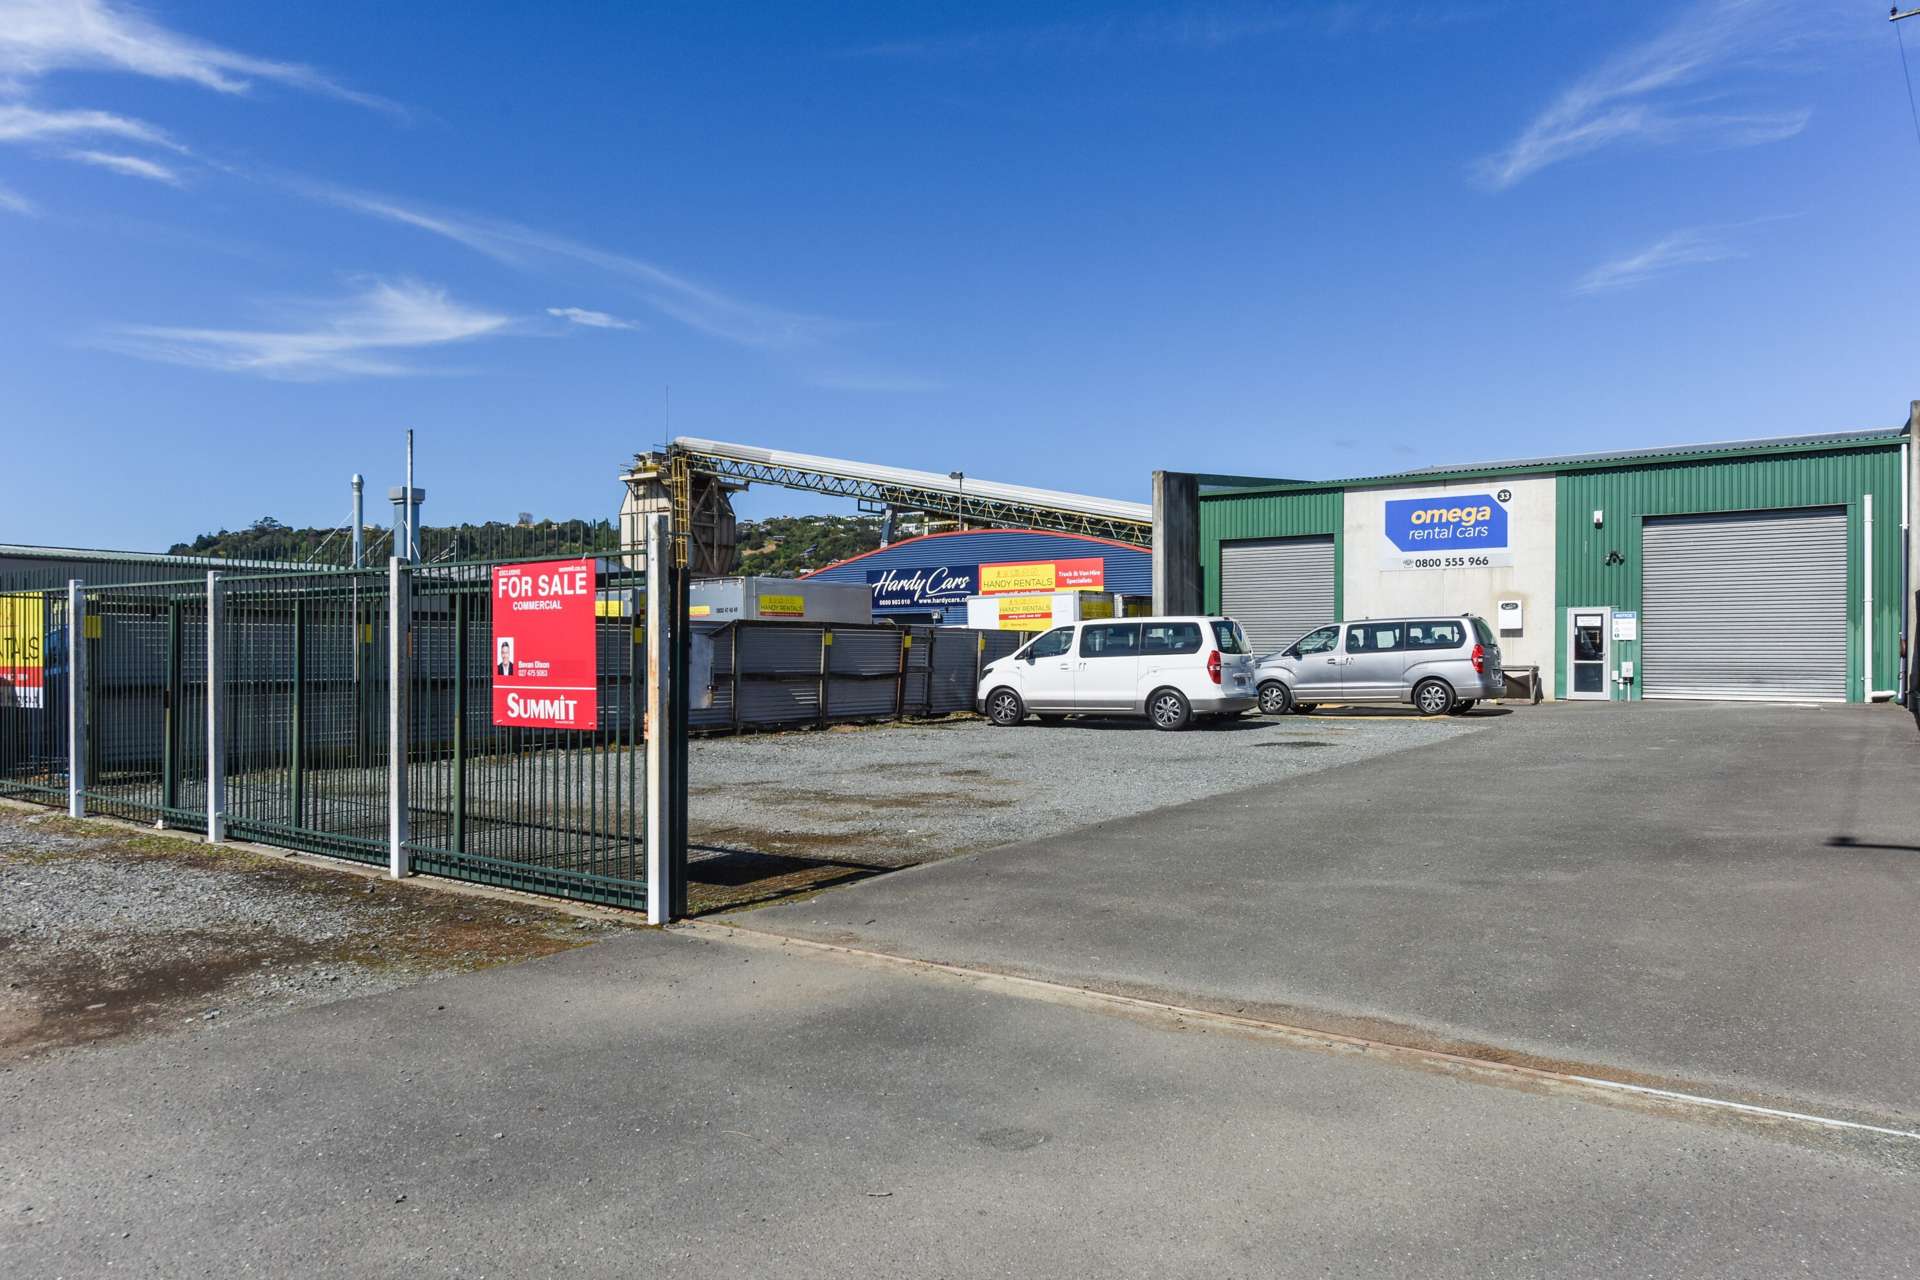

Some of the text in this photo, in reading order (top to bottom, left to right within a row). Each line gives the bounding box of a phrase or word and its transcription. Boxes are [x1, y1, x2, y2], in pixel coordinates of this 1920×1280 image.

[1499, 492, 1510, 500] 33
[1410, 505, 1491, 526] omega
[1408, 525, 1489, 540] rental cars
[1415, 556, 1489, 568] 0800 555 966
[498, 573, 587, 598] FOR SALE
[872, 567, 970, 601] Hardy Cars
[983, 577, 1053, 588] HANDY RENTALS
[513, 599, 562, 611] COMMERCIAL
[507, 692, 578, 721] SUMMIT
